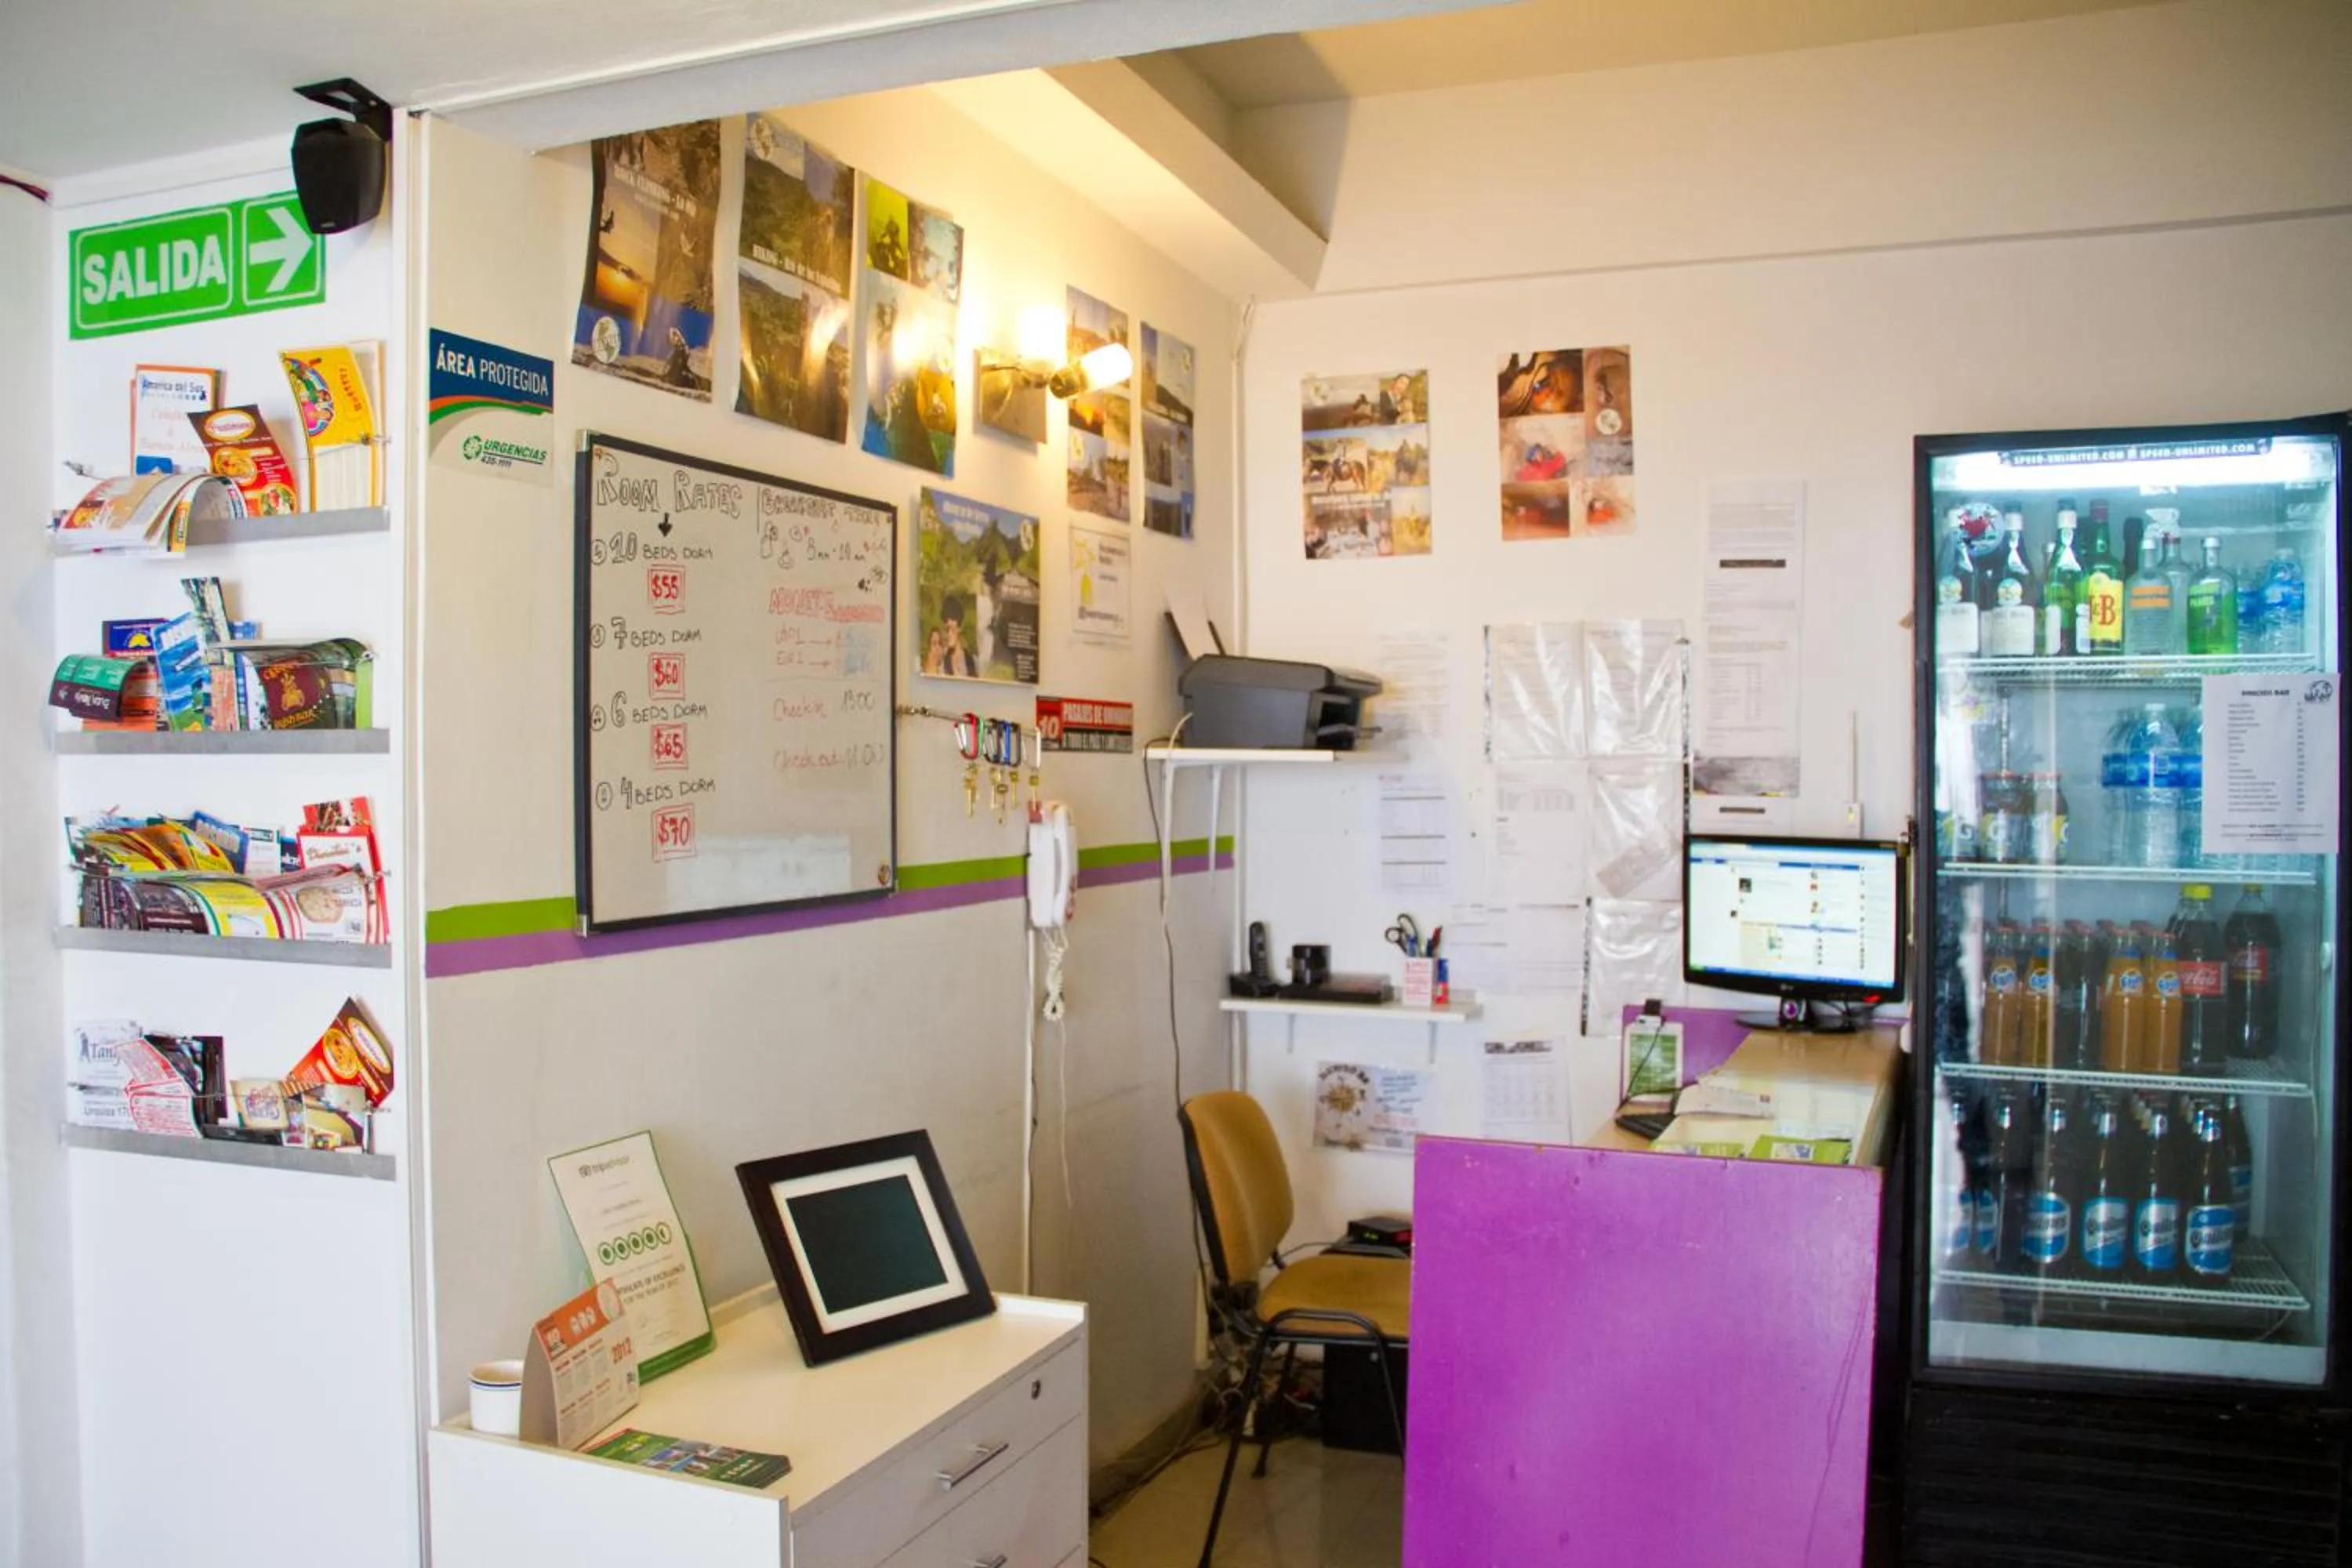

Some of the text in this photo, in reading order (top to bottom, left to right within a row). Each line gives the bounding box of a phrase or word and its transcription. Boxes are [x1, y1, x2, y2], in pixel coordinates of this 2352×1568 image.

[82, 234, 227, 306] SALIDA
[436, 343, 550, 396] ÁREA PROTEGIDA
[483, 438, 548, 461] URGENCIAS
[2013, 450, 2125, 465] SPEED-UNLIMITED.COM
[2140, 443, 2256, 459] SPEED-UNLIMITED.COM
[596, 453, 743, 519] ROOM RATES
[643, 546, 678, 560] BEDS
[683, 545, 713, 560] DORM
[652, 575, 681, 601] $55
[630, 631, 666, 648] BEDS
[672, 626, 702, 643] DORM
[654, 657, 680, 687] $60
[611, 691, 709, 728] 6 BEDS DORM
[654, 728, 684, 766] $65
[634, 787, 673, 806] BEDS
[679, 778, 717, 795] DORM
[658, 815, 691, 847] $70
